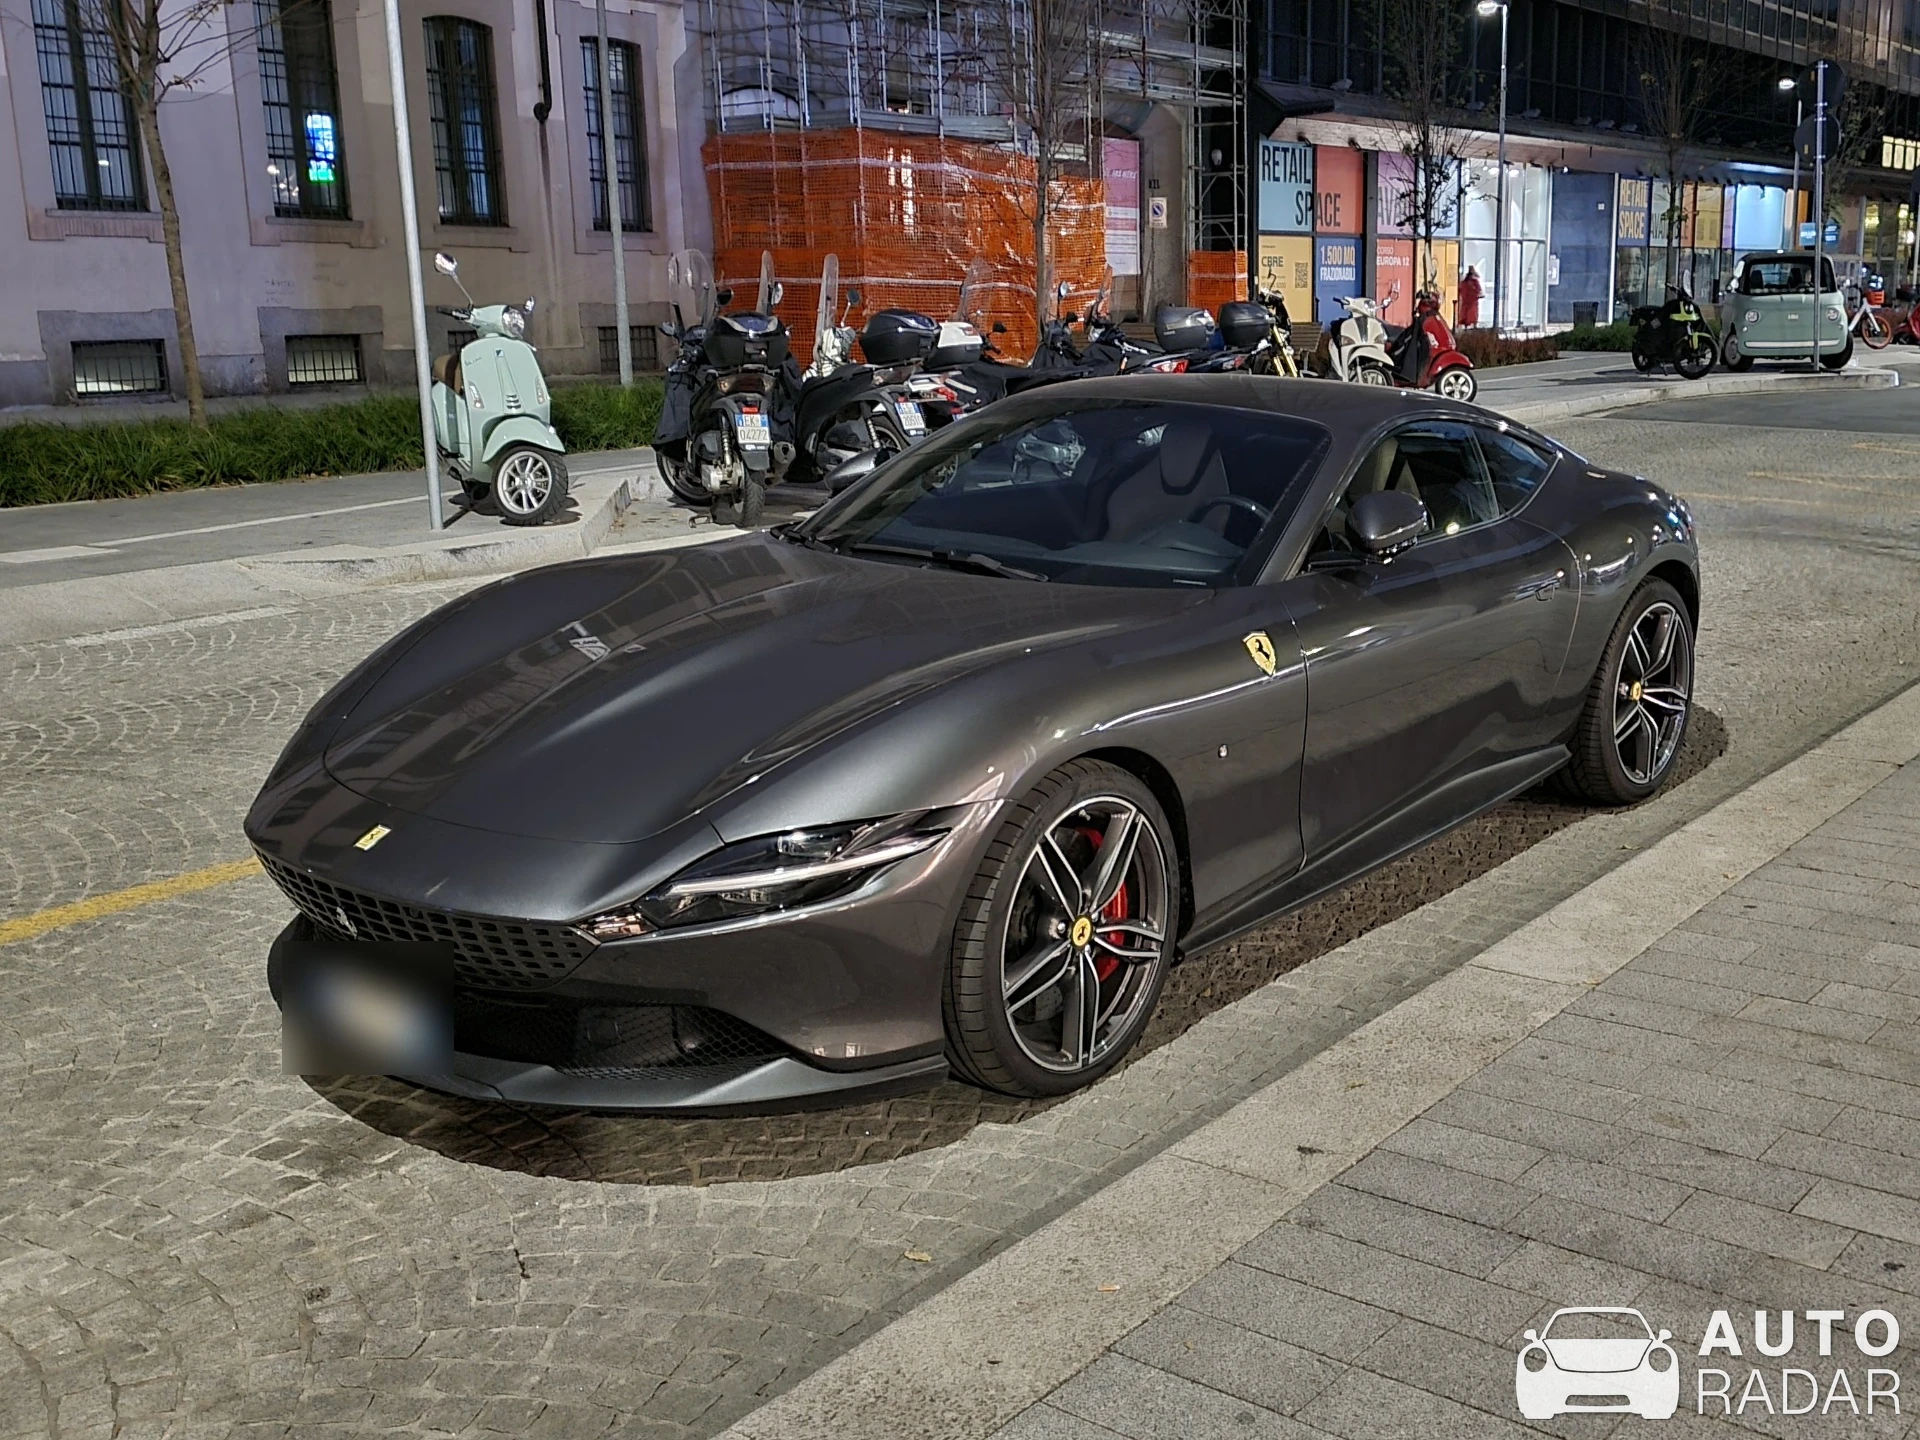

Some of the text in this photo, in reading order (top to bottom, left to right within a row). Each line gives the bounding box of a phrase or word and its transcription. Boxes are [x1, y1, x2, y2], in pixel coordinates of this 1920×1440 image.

[1262, 145, 1311, 184] RETAIL
[1619, 178, 1648, 208] RETAIL
[1295, 190, 1341, 227] SPACE
[1618, 211, 1646, 239] SPACE
[1261, 256, 1284, 267] CBRE
[1320, 245, 1356, 266] 1.500 MQ
[1376, 256, 1410, 266] EUROPA 12
